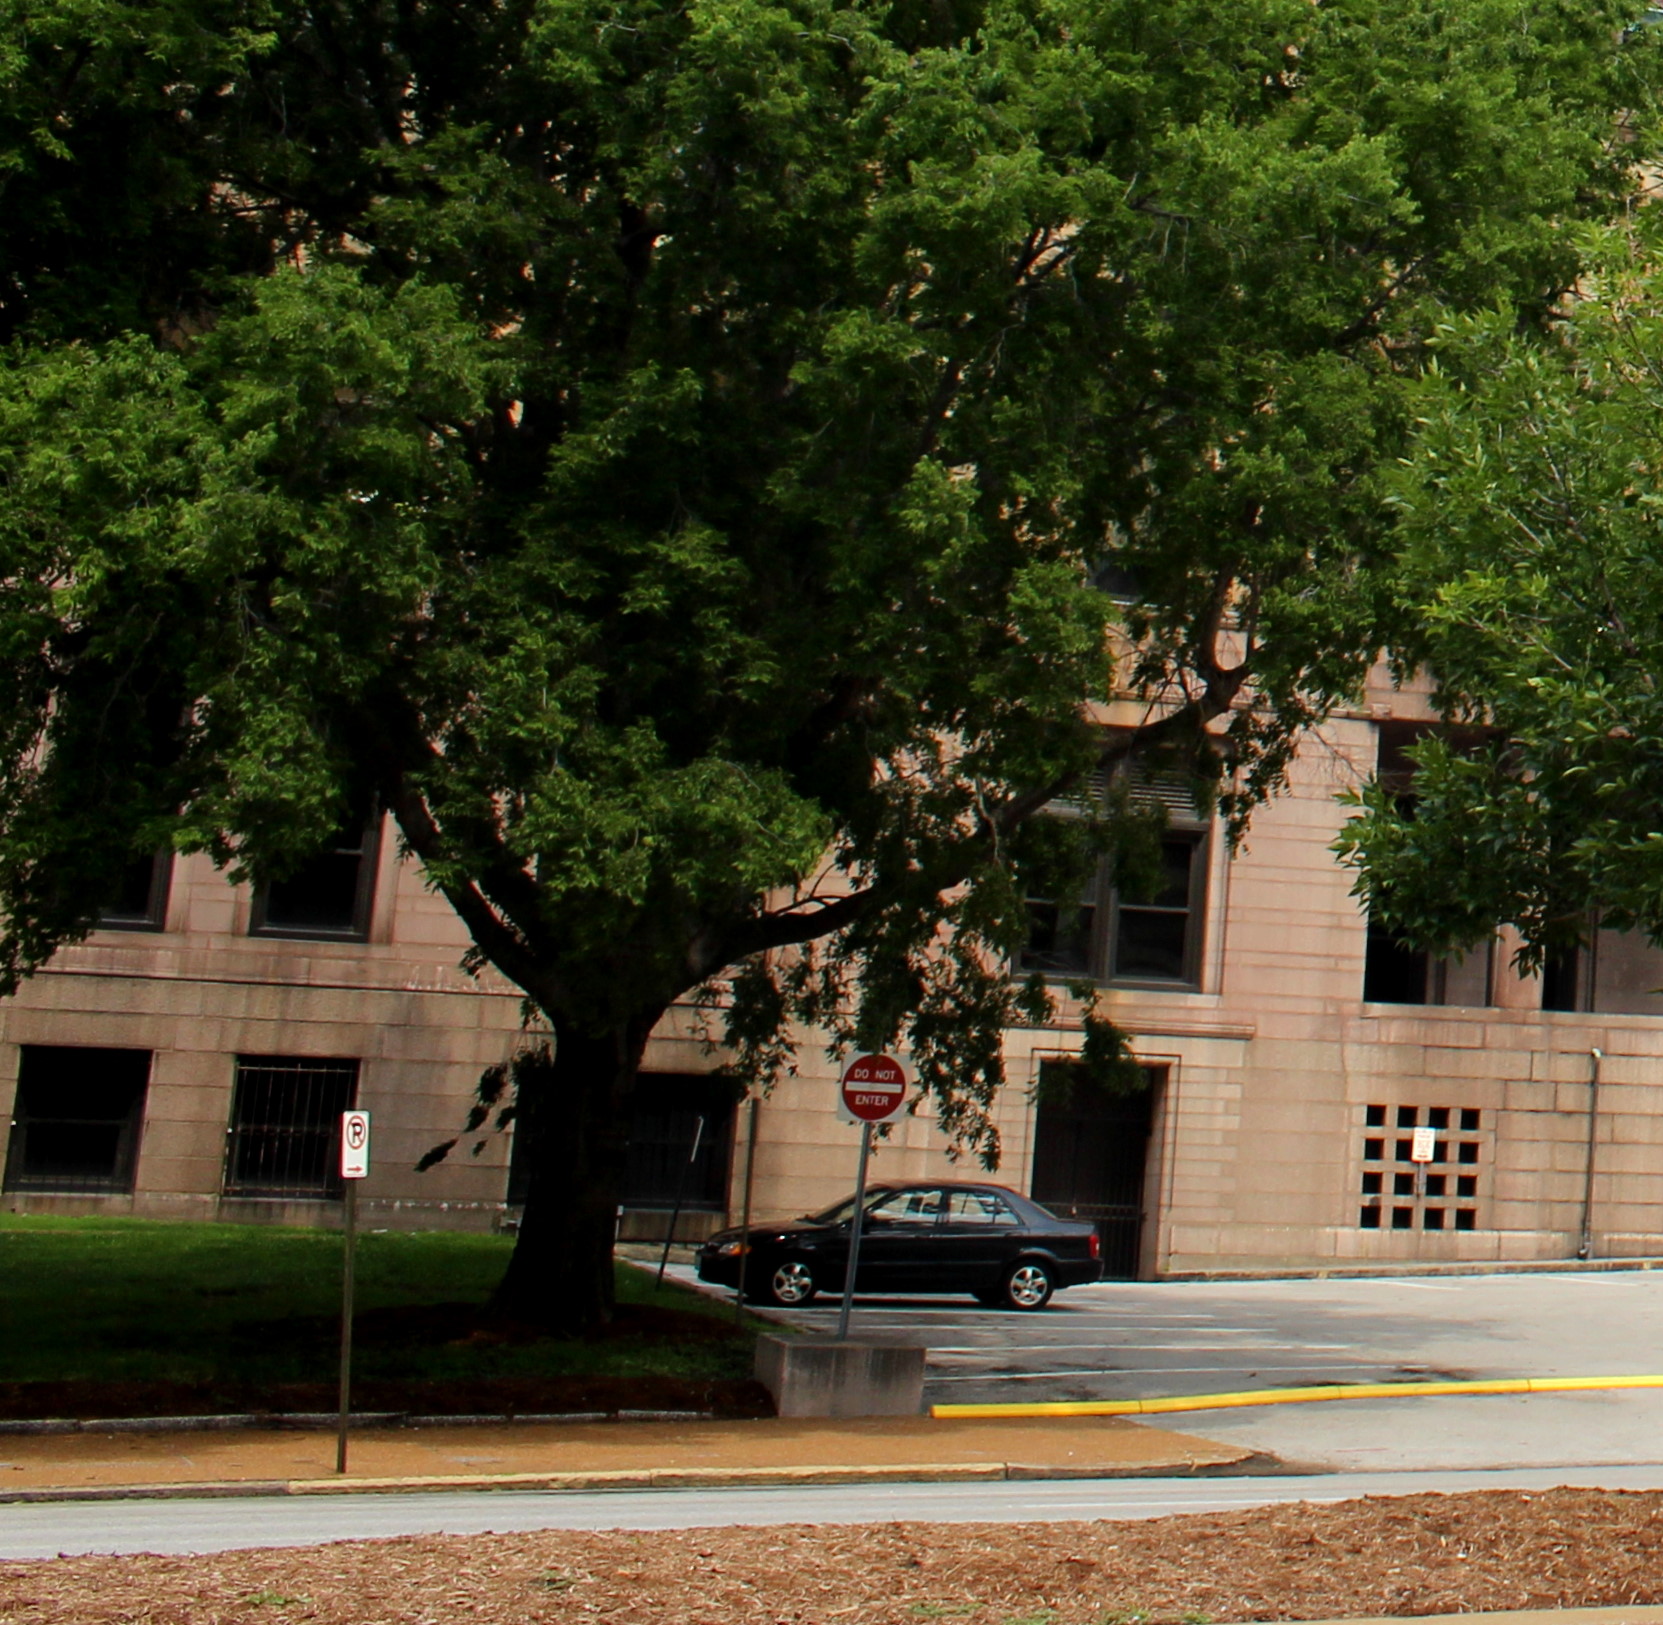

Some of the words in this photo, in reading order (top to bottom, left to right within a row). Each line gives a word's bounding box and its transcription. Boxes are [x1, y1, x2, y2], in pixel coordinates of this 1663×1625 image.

[854, 1069, 869, 1079] DO
[875, 1070, 896, 1080] NOT
[855, 1094, 889, 1106] ENTER
